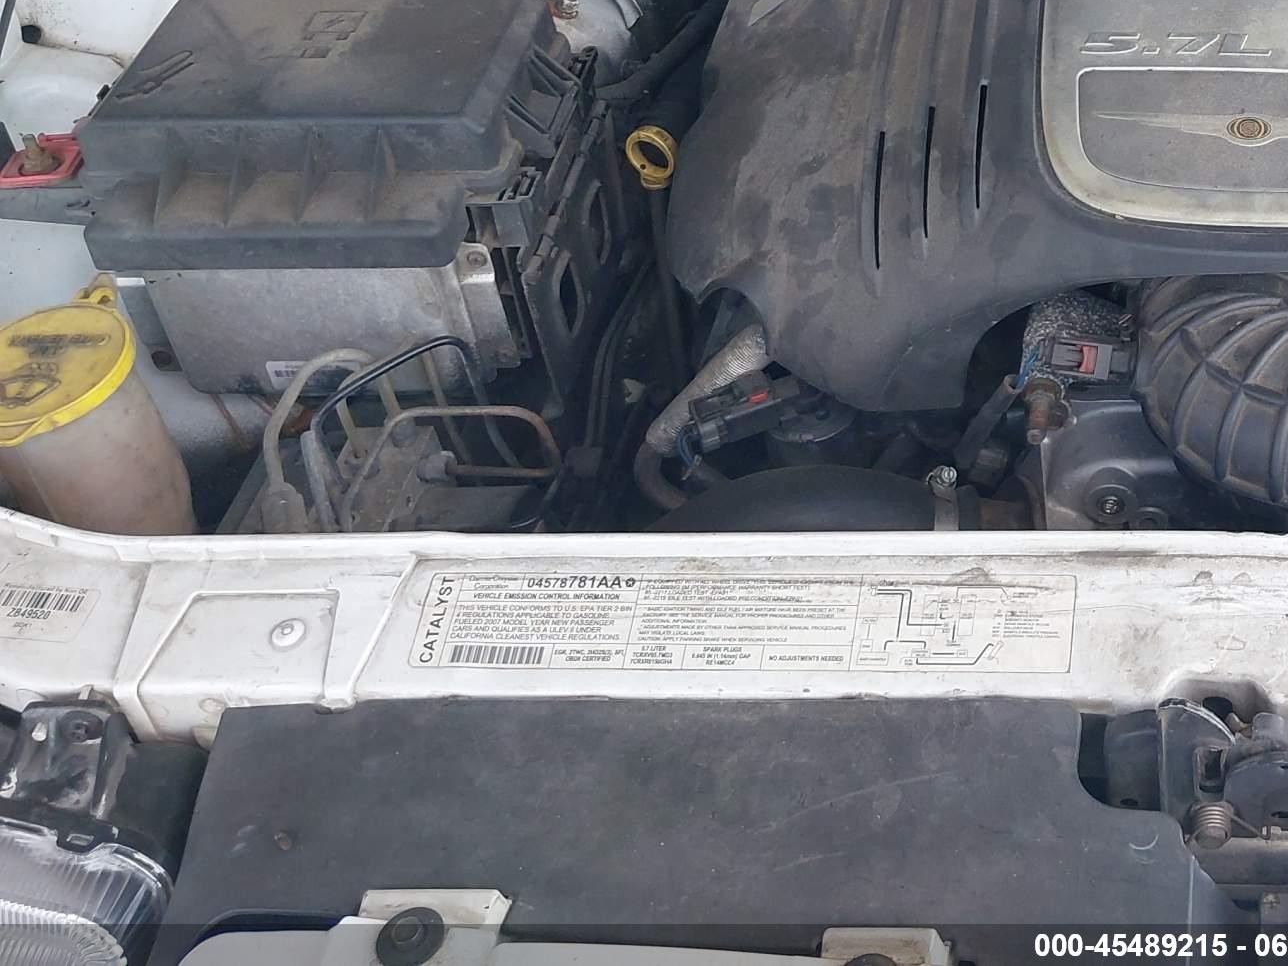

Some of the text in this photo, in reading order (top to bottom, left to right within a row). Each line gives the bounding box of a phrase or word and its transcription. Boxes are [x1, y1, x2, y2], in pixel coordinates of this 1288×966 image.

[1079, 32, 1272, 57] 5.7L
[527, 576, 622, 588] 04578781AA
[420, 576, 455, 663] CATALYST
